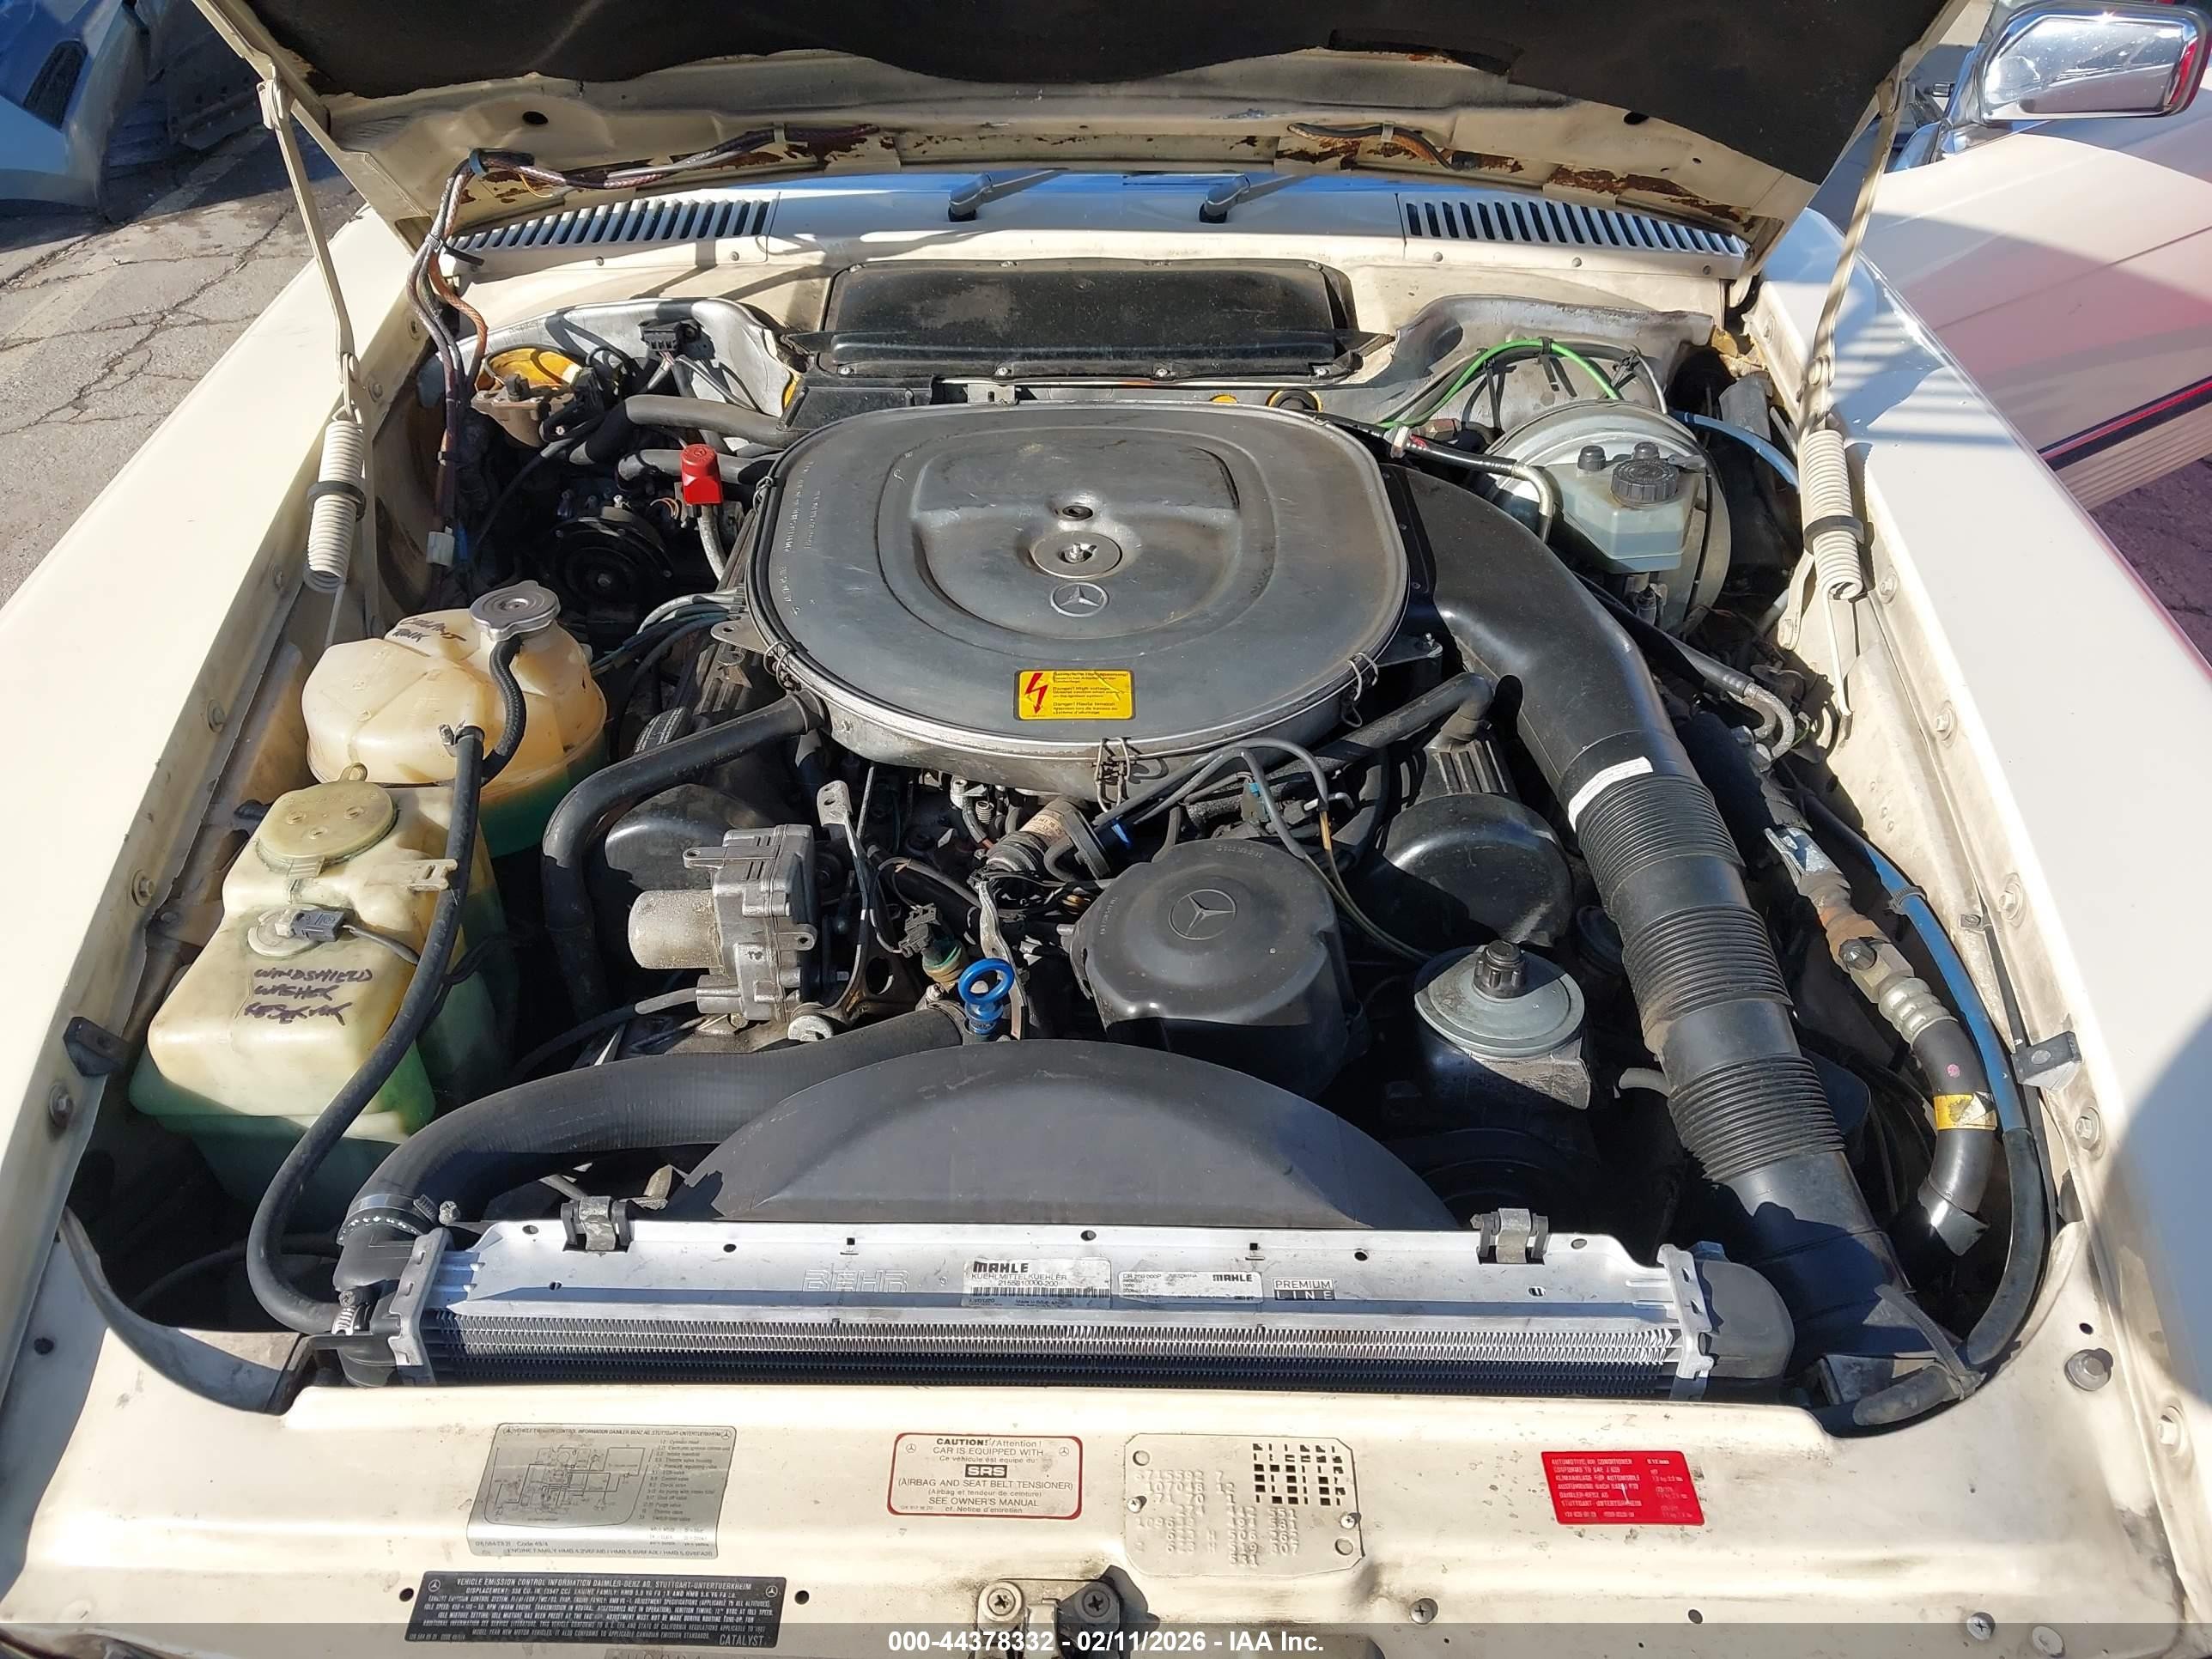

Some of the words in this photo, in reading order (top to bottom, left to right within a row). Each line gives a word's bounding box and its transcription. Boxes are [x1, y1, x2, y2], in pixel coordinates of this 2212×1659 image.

[973, 1261, 1030, 1273] MAHLE
[802, 1269, 908, 1292] BEHR
[1212, 1273, 1253, 1283] MAHLE
[1275, 1279, 1332, 1290] PREMIUM
[936, 1437, 988, 1447] CAUTION!
[969, 1447, 1017, 1456] EQUIPPED
[966, 1466, 1006, 1477] SRS
[898, 1478, 937, 1487] (AIRBAG
[939, 1479, 960, 1487] AND
[963, 1480, 988, 1488] SEAT
[1016, 1481, 1074, 1491] TENSIONER)
[951, 1497, 996, 1506] OWNER'S
[999, 1498, 1038, 1507] MANUAL
[457, 1577, 483, 1586] VEHICLE
[484, 1577, 516, 1587] EMISSION
[517, 1578, 546, 1587] CONTROL
[547, 1578, 592, 1588] INFORMATION
[592, 1579, 641, 1588] DAIMLER-BENZ
[654, 1580, 752, 1590] STUTTGART-UNTERTUERKHEIM
[719, 1634, 766, 1647] CATALYST
